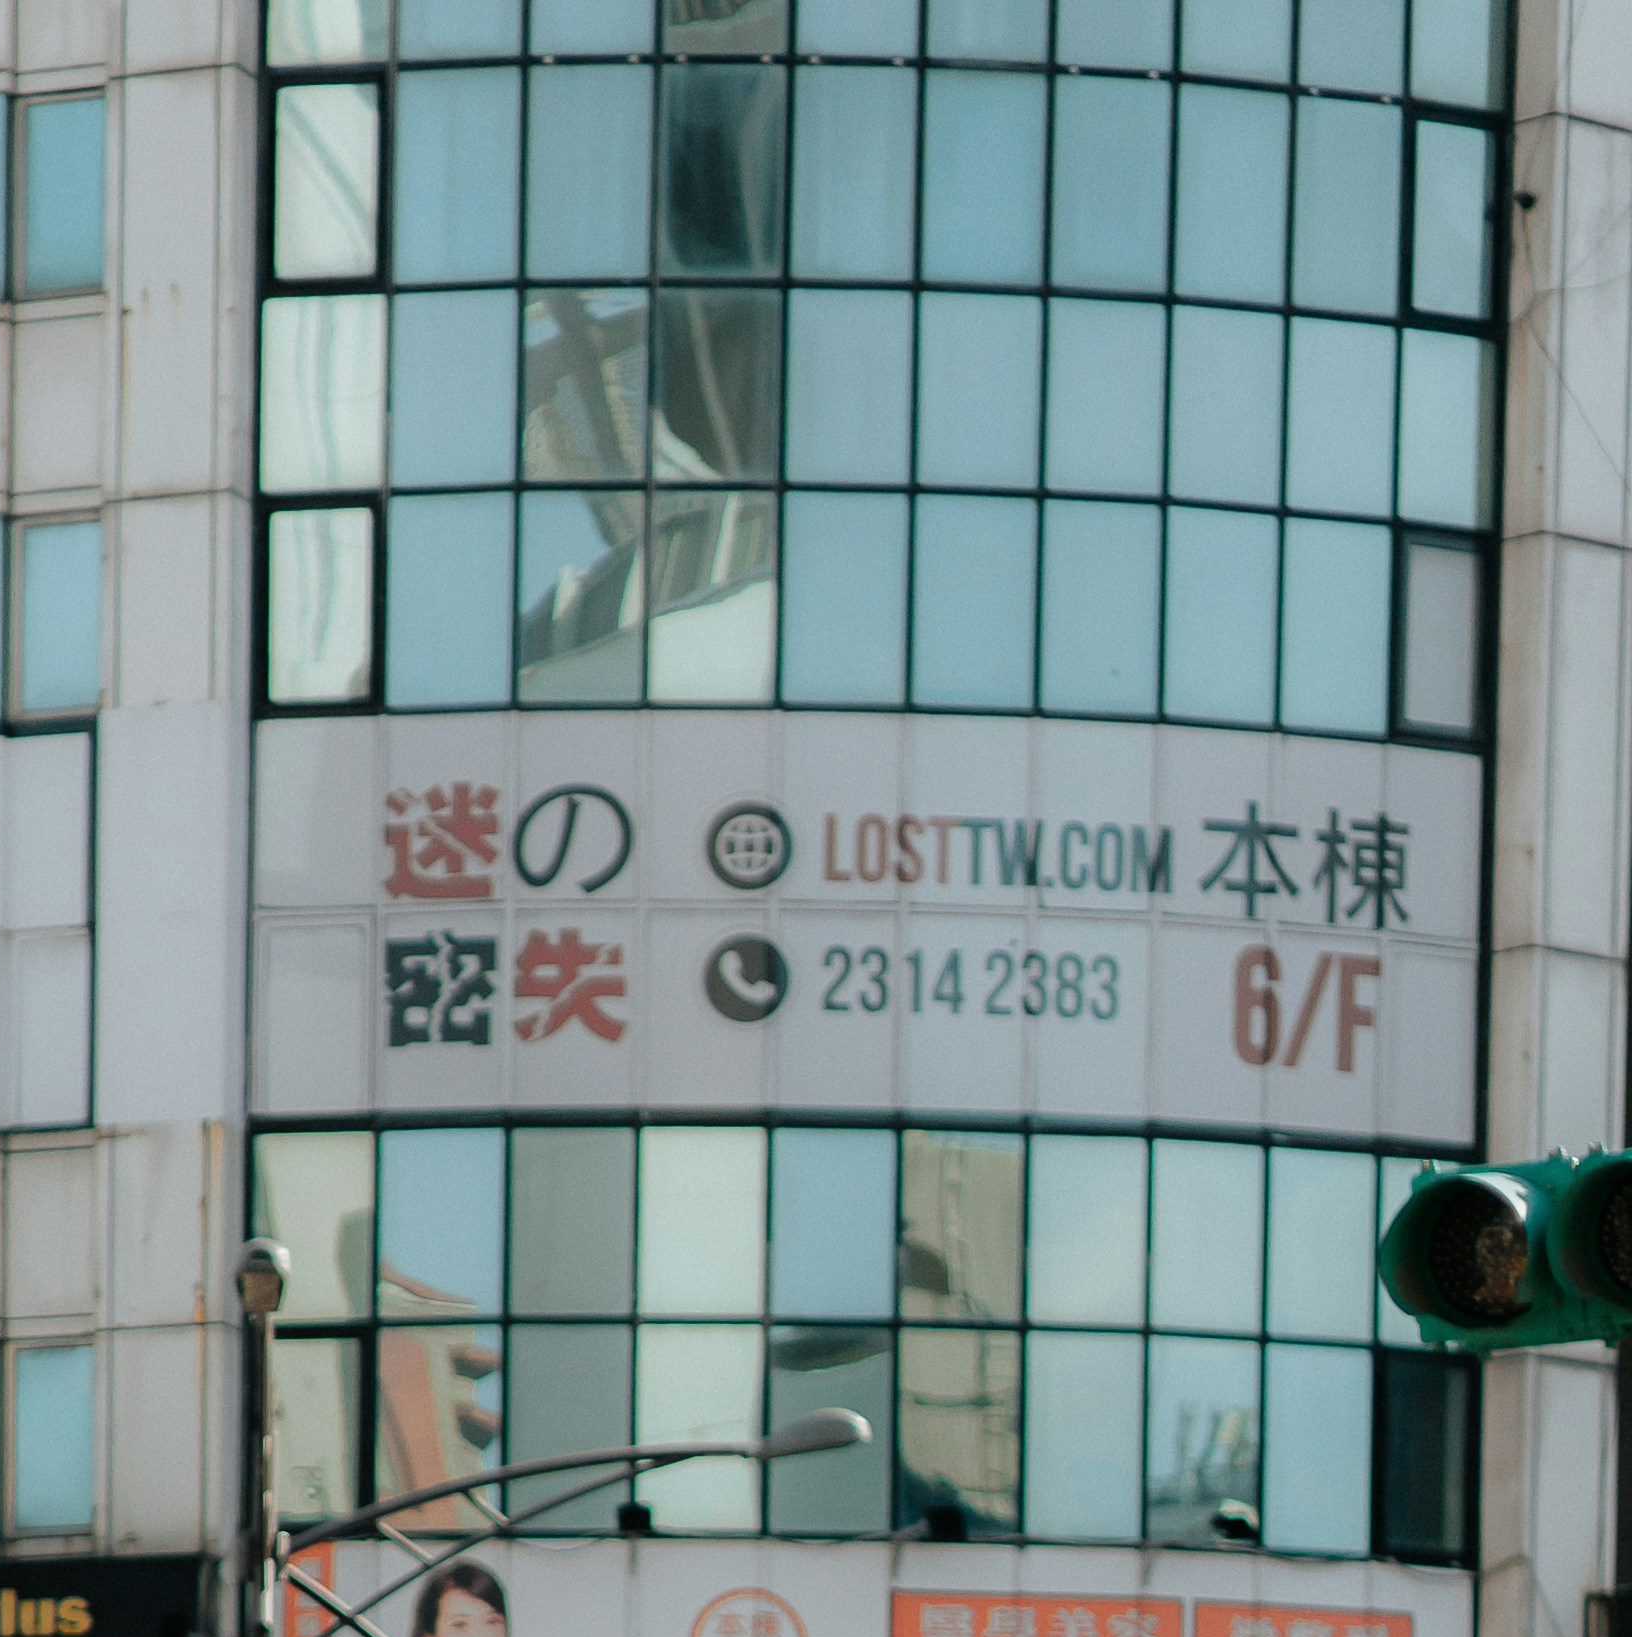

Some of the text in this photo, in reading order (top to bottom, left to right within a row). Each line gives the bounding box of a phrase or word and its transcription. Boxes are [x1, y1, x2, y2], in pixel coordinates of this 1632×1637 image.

[382, 782, 633, 900] 迷の
[822, 812, 1174, 896] LOSTTW.COM
[1199, 801, 1411, 930] 本棟
[1231, 942, 1382, 1073] 6/F
